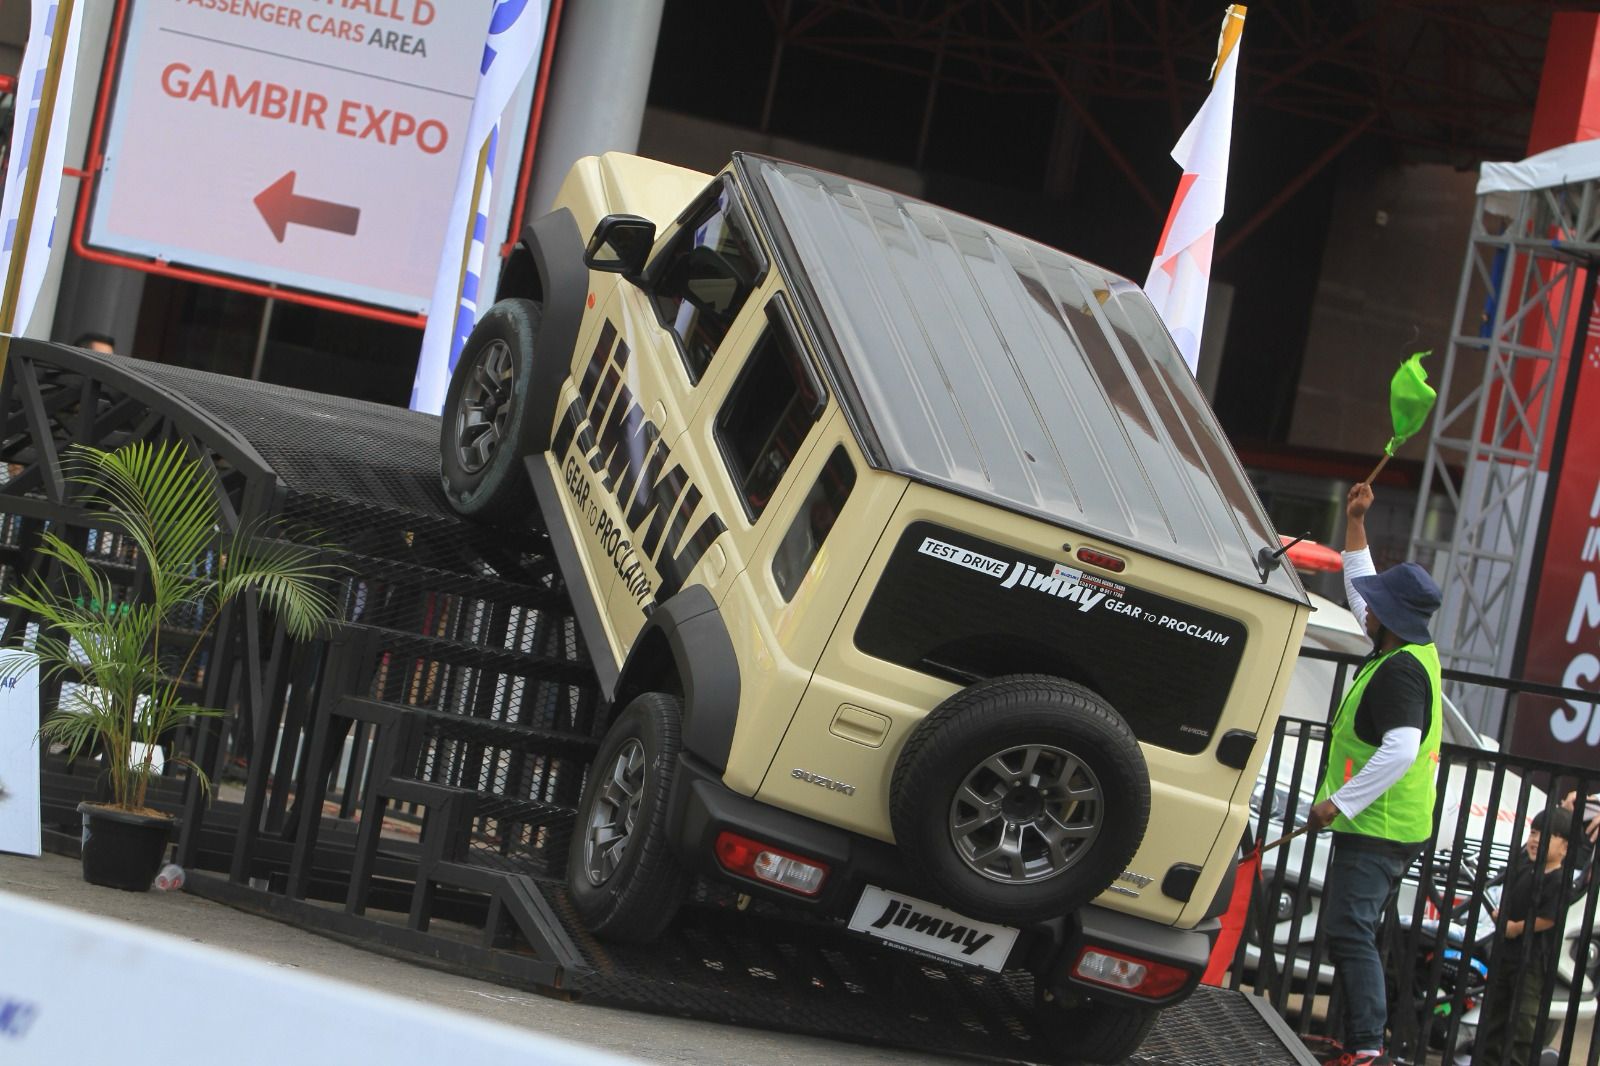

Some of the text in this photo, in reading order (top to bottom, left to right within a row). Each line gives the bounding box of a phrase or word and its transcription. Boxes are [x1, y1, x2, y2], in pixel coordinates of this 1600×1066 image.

[176, 0, 428, 58] SSENGER CARS AREA
[412, 0, 436, 26] D
[160, 62, 449, 155] GAMBIR EXPO
[565, 455, 652, 606] GEAR TO PROCLAIM
[924, 540, 1005, 576] TEST DRIVE
[1000, 561, 1106, 613] Jimny
[1104, 598, 1230, 647] GEAR TO PROCLAIM
[791, 767, 857, 797] SUZUKI
[870, 899, 995, 956] Jimny
